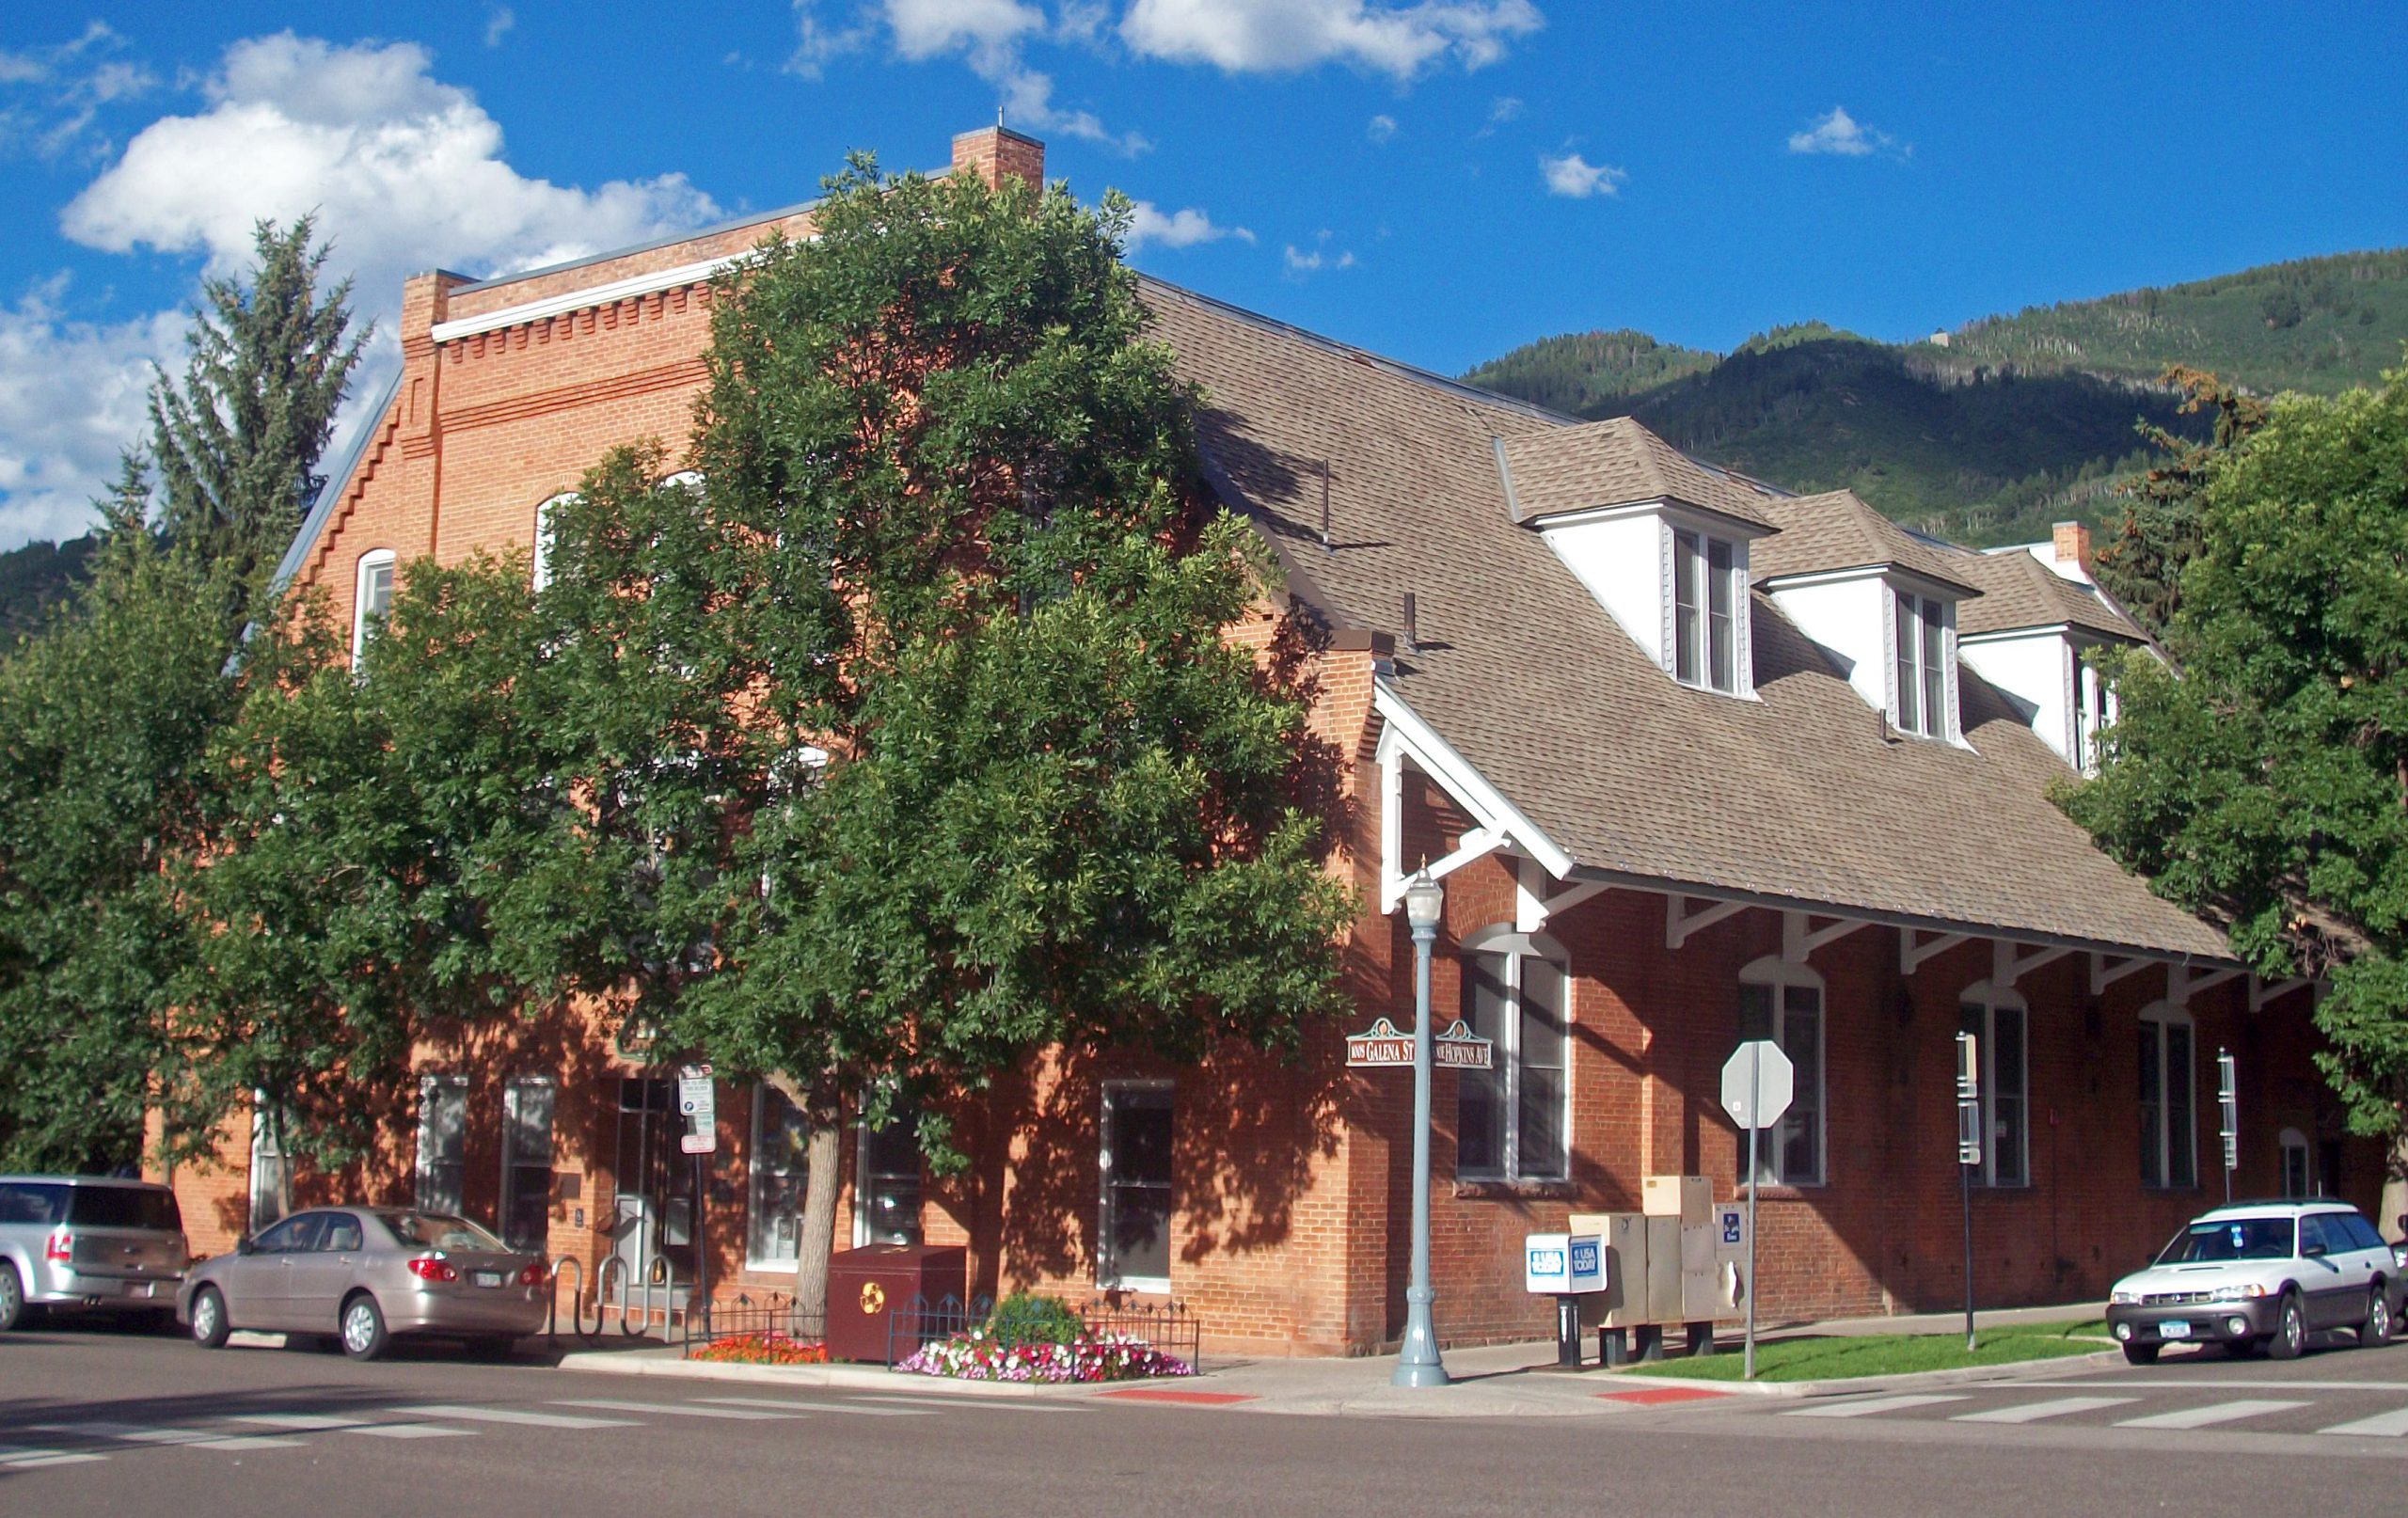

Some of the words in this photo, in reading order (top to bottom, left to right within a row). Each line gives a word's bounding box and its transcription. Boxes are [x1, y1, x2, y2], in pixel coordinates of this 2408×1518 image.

[1367, 1042, 1400, 1061] GALENA
[1402, 1040, 1414, 1060] ST
[1445, 1043, 1474, 1064] HOPKINS
[1475, 1046, 1488, 1064] AVE
[1580, 1248, 1596, 1259] USA
[1531, 1261, 1562, 1273] TODAY
[1574, 1259, 1596, 1272] TODAY
